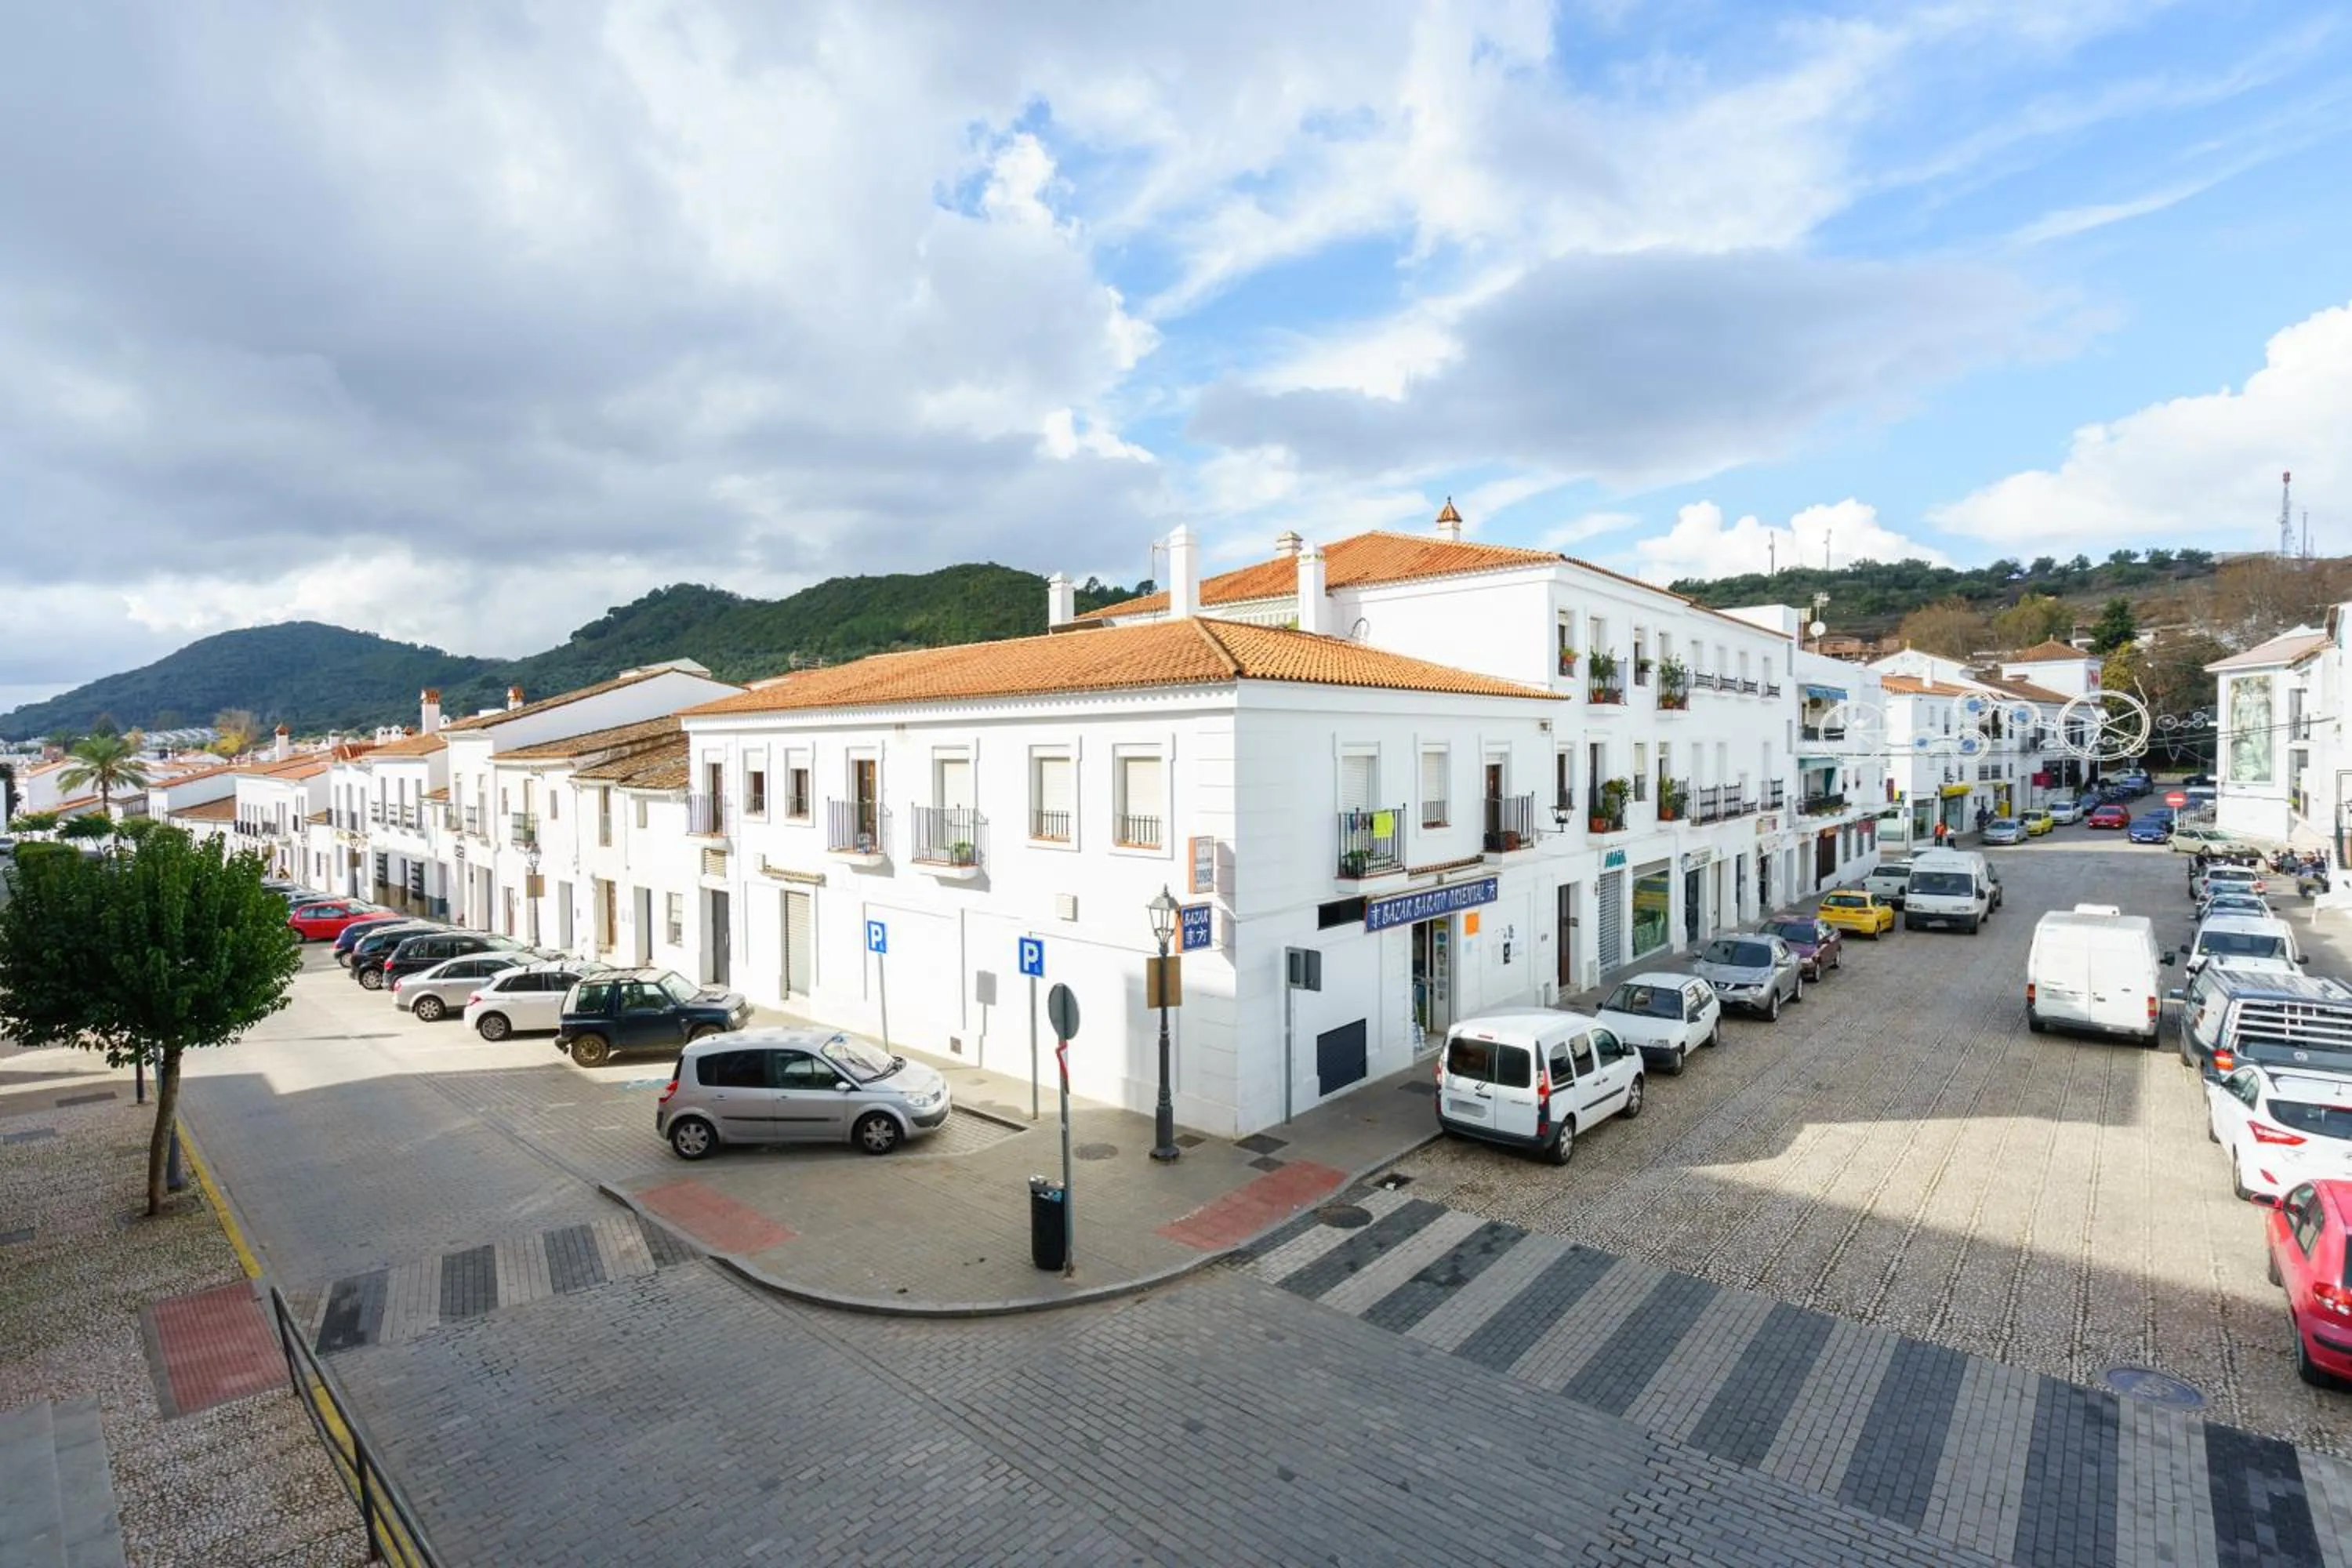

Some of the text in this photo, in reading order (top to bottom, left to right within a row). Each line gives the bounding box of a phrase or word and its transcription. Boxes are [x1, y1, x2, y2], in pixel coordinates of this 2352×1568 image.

[1185, 909, 1208, 926] BAZAR
[1382, 899, 1412, 924] BAZAR
[1414, 891, 1448, 916] BARATO
[1450, 884, 1486, 907] ORIENTAL
[869, 923, 883, 949] P
[1023, 942, 1039, 971] P
